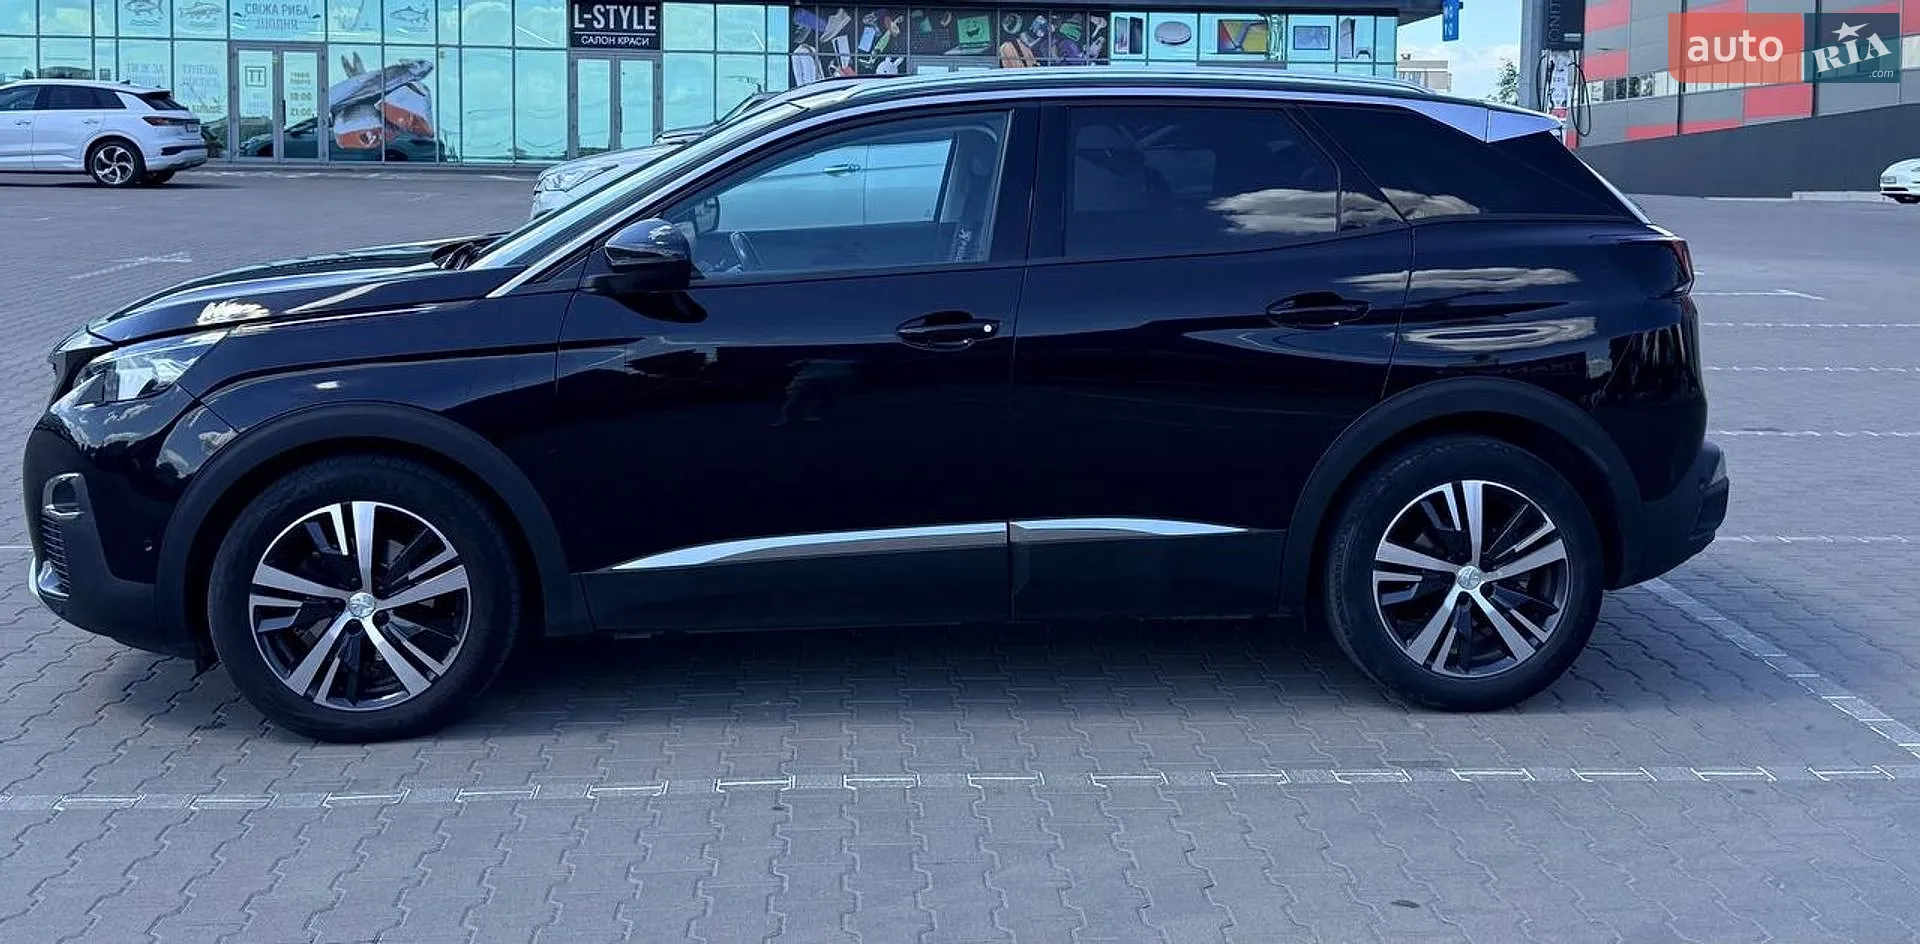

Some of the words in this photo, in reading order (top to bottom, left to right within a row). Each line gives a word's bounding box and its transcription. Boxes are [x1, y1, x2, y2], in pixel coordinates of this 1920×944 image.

[574, 4, 656, 30] L-STYLE
[580, 35, 616, 45] САЛОН
[617, 36, 650, 46] КРАСИ
